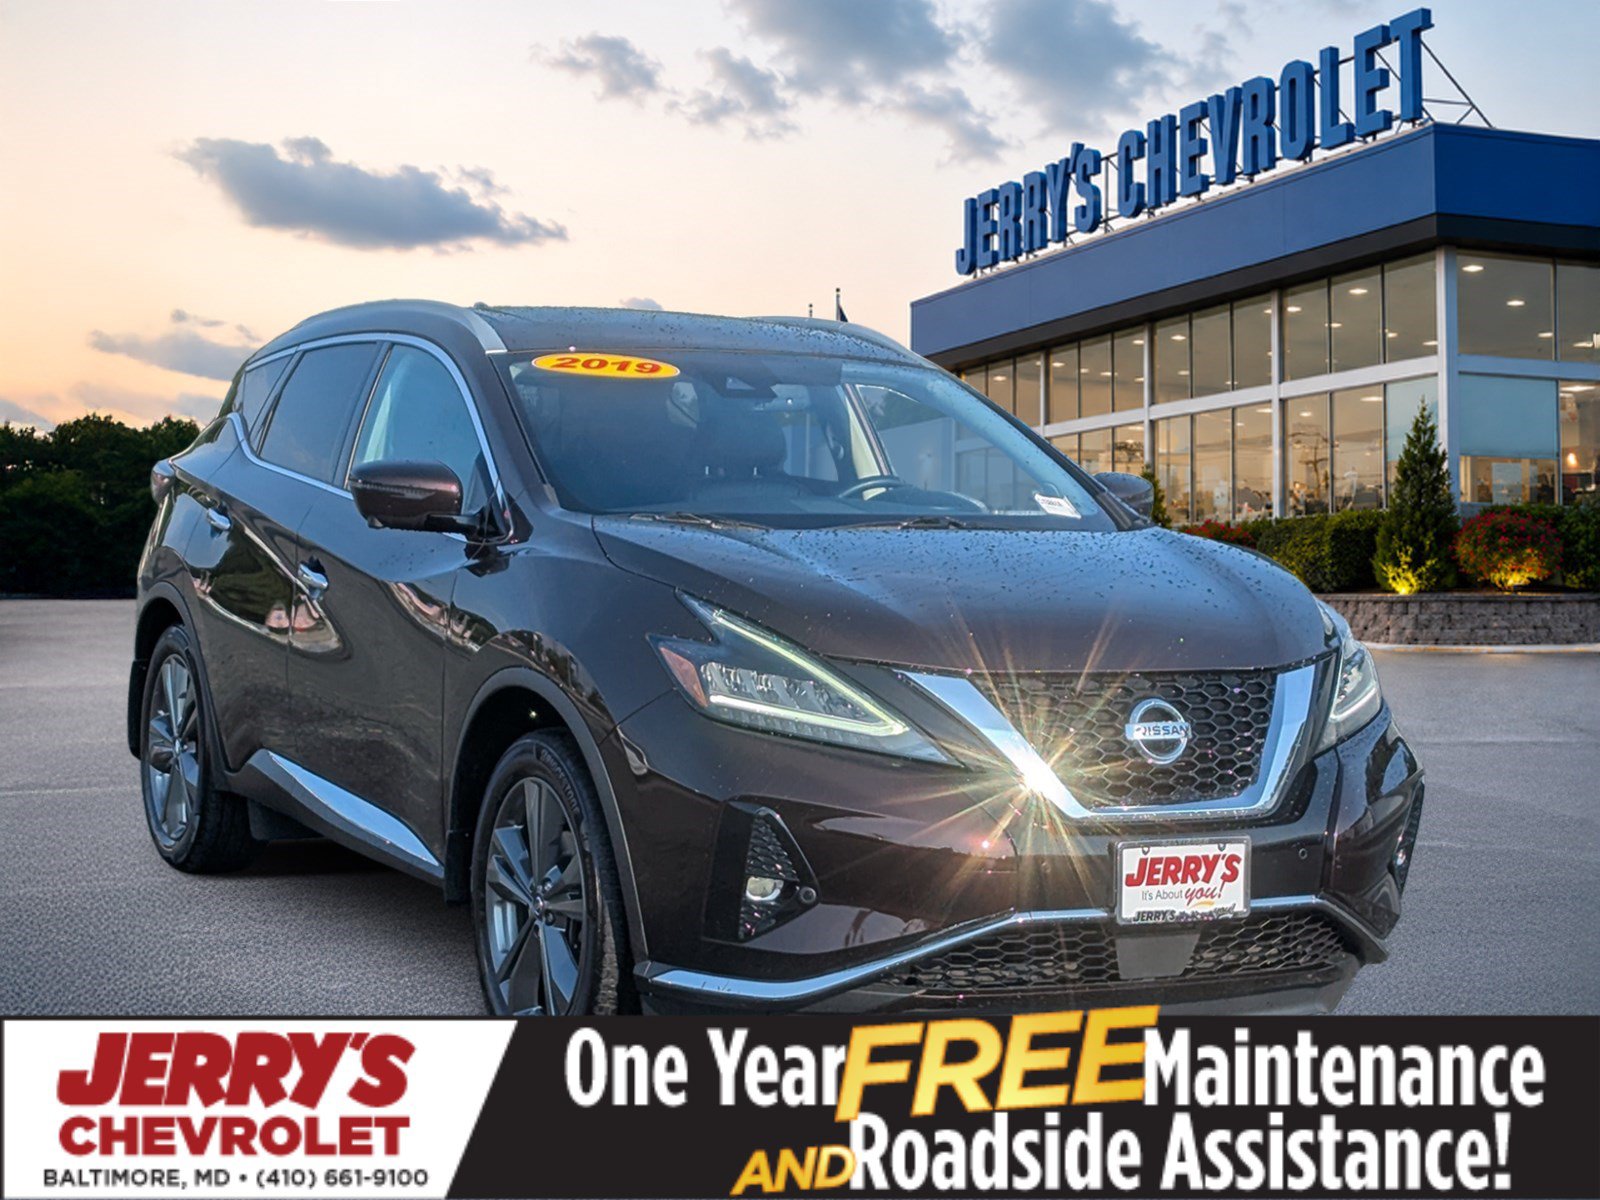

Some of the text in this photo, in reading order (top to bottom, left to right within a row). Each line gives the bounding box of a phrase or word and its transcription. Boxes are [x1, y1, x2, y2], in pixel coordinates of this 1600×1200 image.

[956, 8, 1434, 275] JERRY'S CHEVROLET
[551, 357, 662, 374] 2019
[1125, 854, 1242, 887] JERRY'S
[1142, 881, 1226, 906] It's About you!
